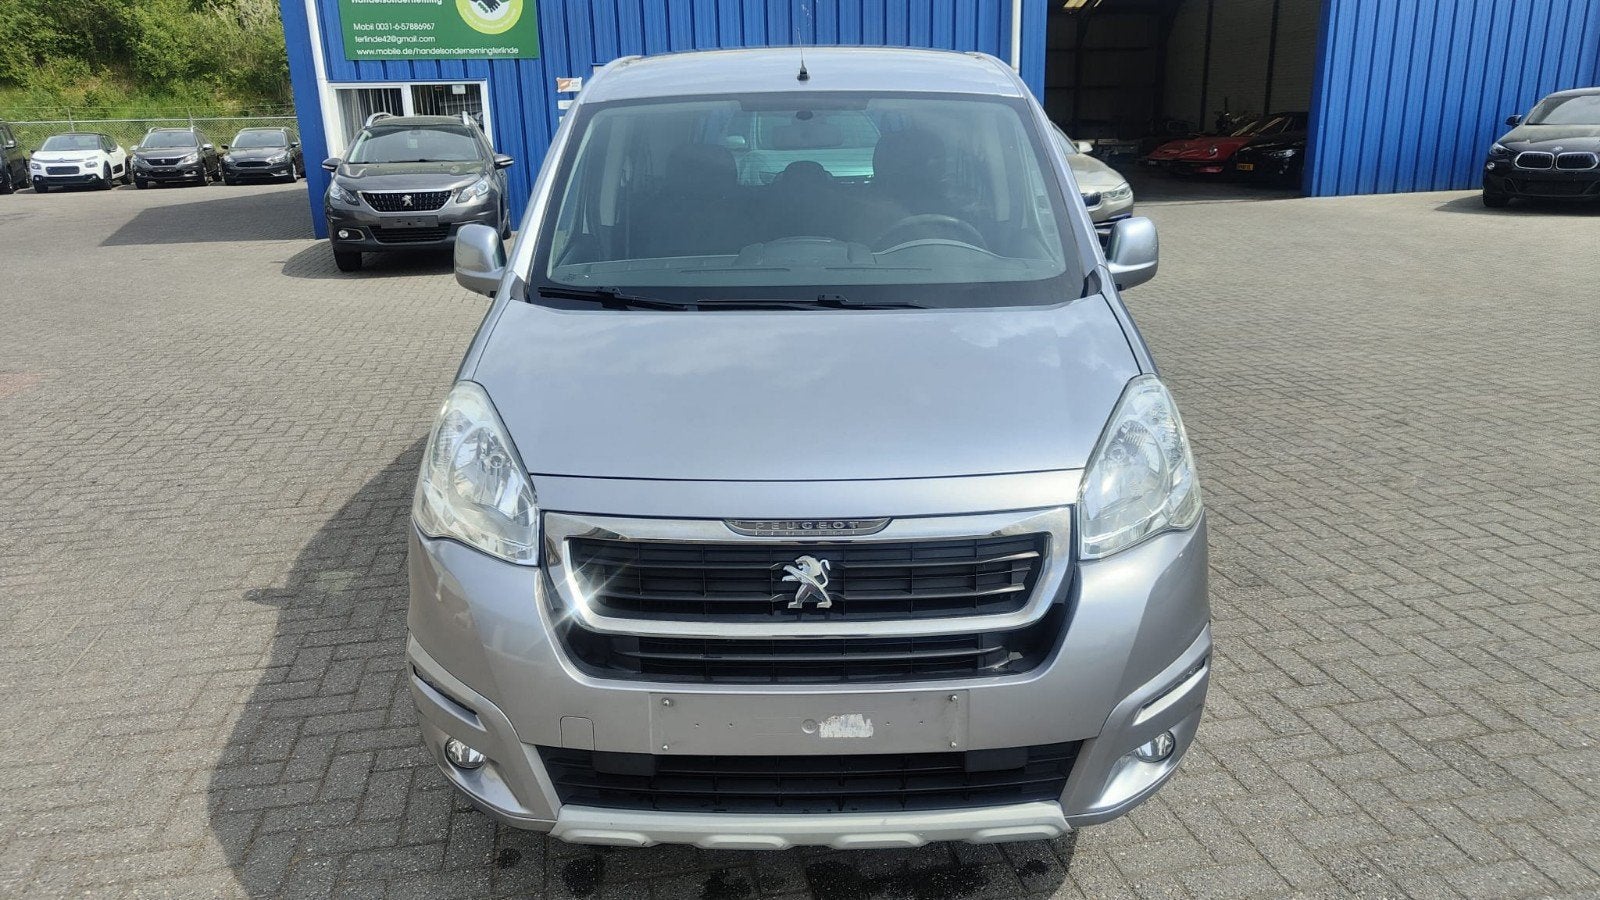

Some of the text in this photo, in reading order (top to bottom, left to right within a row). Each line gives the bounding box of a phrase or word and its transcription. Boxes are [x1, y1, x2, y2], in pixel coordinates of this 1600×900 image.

[353, 22, 435, 30] Mobil 0031-6-57886967
[355, 35, 436, 44] terlinde42@gmail.com
[356, 47, 519, 56] www.mobile.de/handelsondernemingterlinde
[755, 521, 859, 530] PEUGEOT
